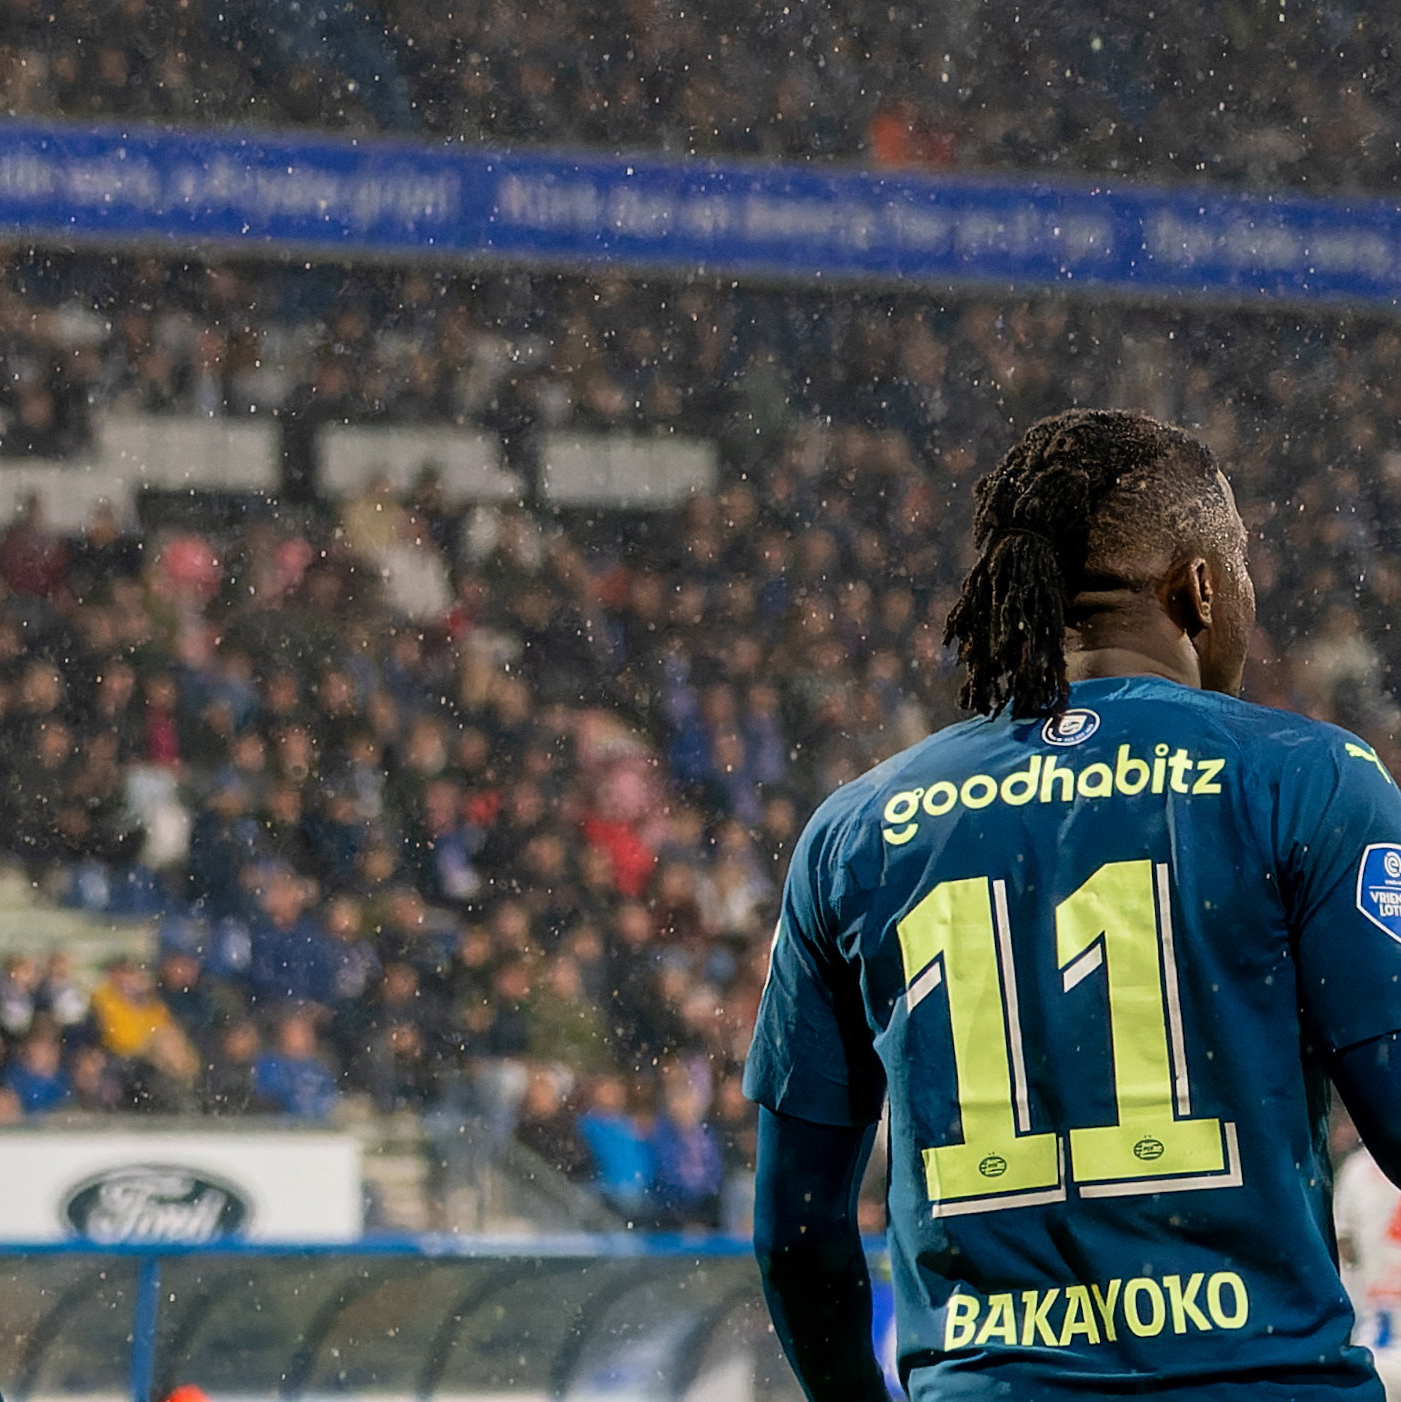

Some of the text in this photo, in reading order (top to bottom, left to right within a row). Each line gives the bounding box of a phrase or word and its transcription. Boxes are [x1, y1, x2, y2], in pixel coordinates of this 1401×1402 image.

[883, 743, 1226, 845] goodhabitz
[897, 859, 1243, 1219] 11
[942, 1271, 1249, 1351] BAKAYOKO
